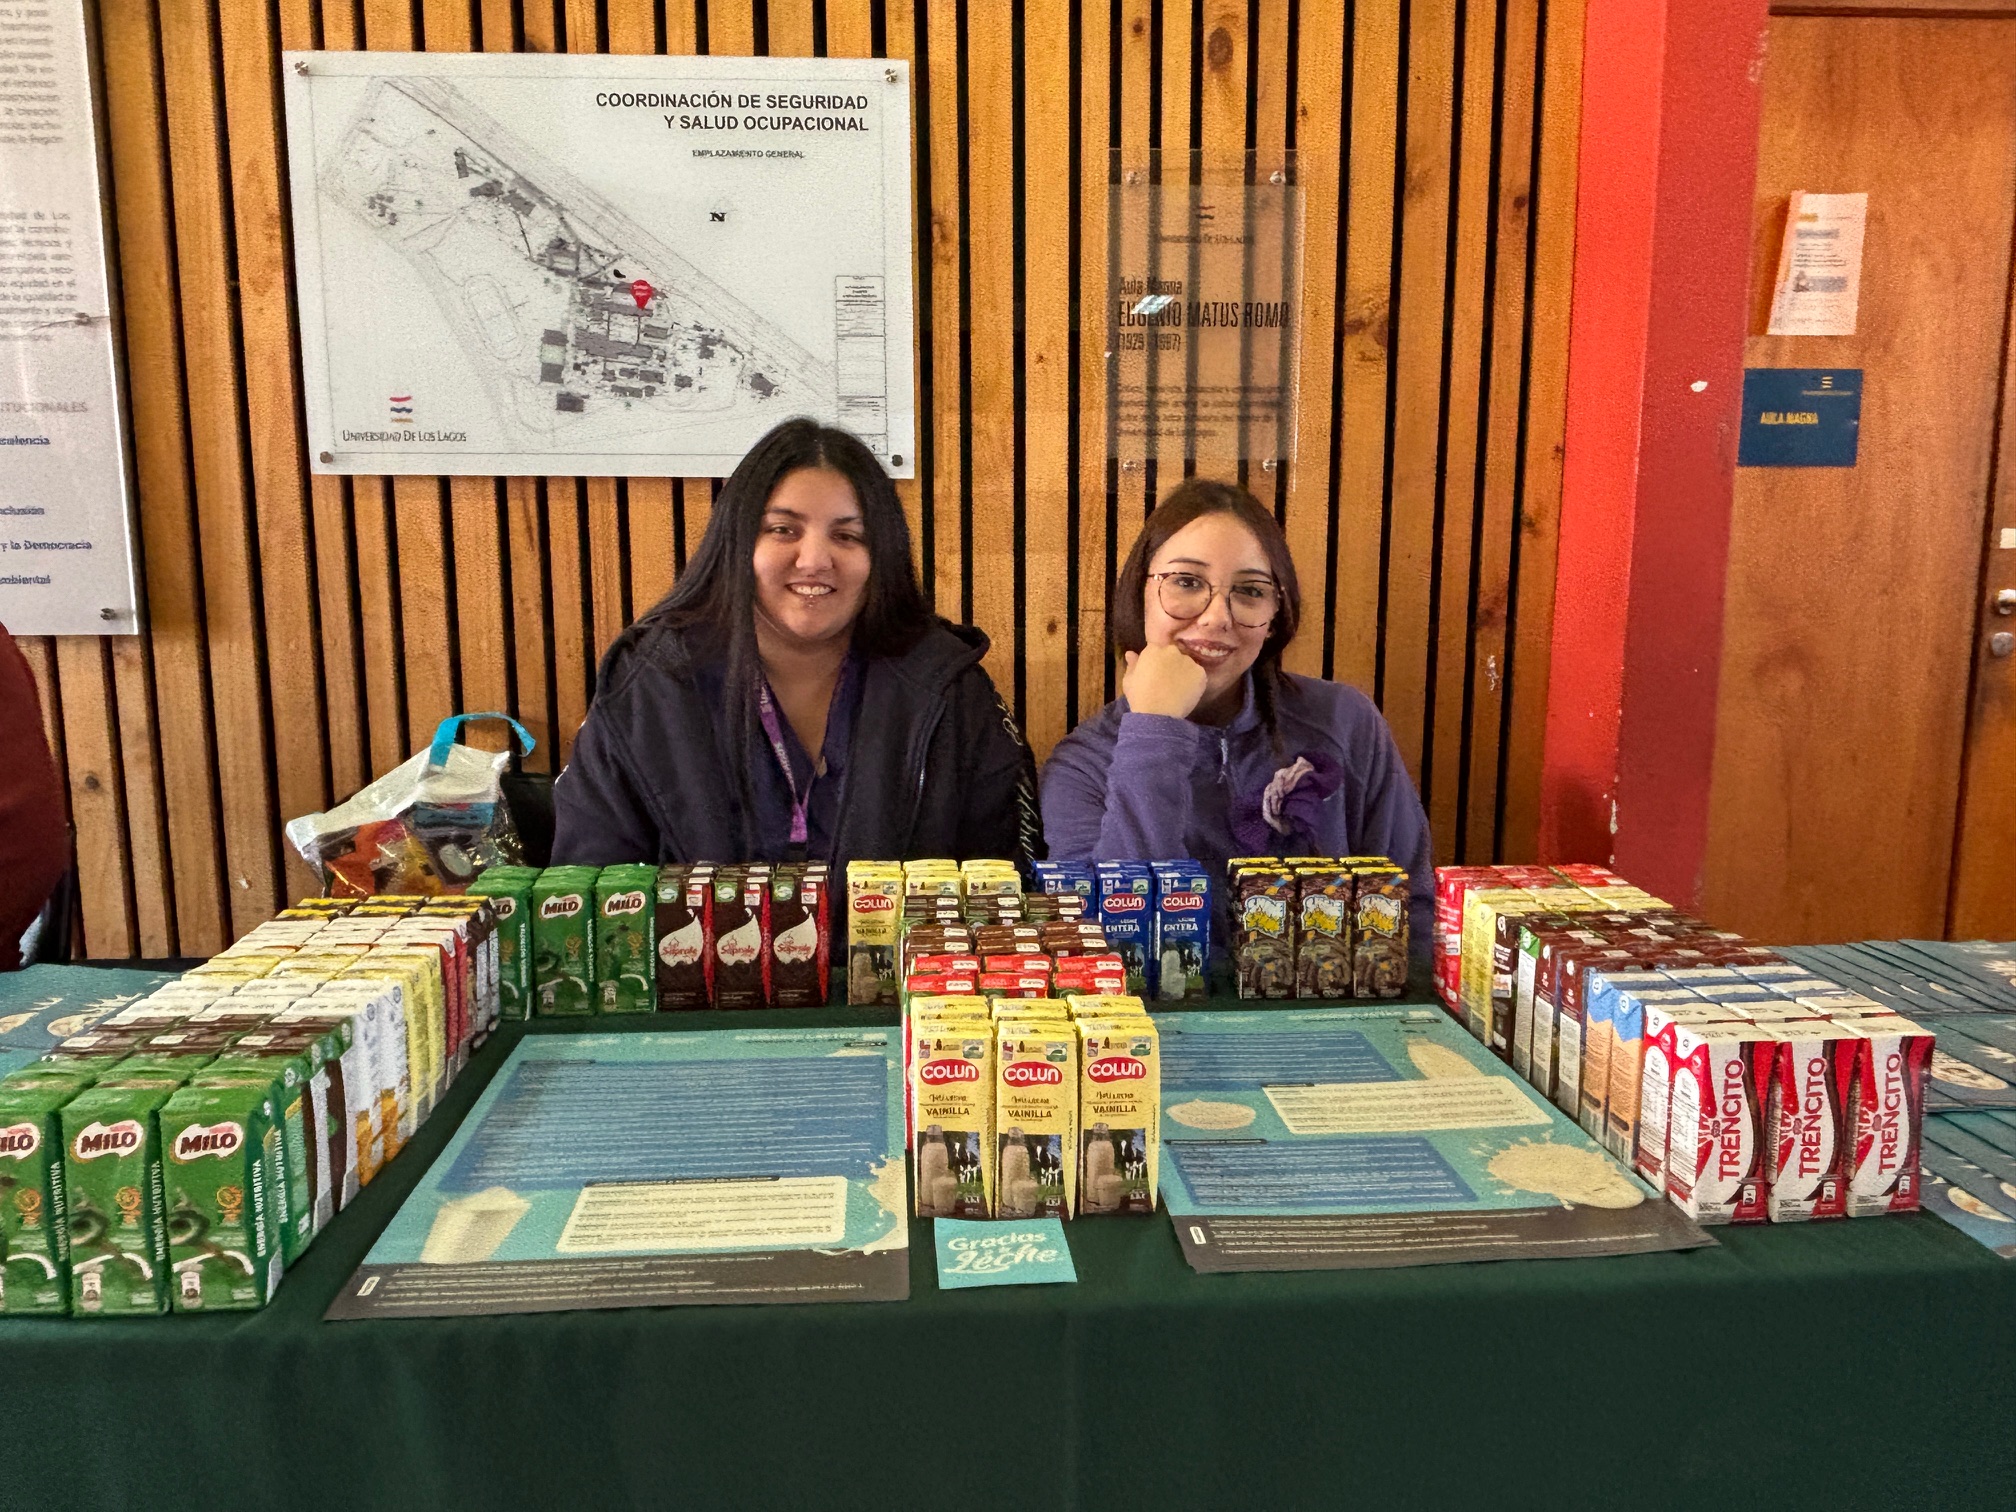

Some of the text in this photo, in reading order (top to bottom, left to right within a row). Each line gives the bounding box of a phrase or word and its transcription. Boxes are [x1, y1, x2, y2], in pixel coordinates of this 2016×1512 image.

[595, 90, 868, 109] COORDINACIÓN DE SEGURIDAD
[663, 115, 869, 131] Y SALUD OCUPACIONAL
[765, 149, 805, 159] GENERAL
[709, 211, 727, 223] N
[1118, 300, 1290, 328] EUGENIO MATUS ROMO
[1760, 411, 1819, 425] AULA MAGNA
[544, 900, 579, 915] MILO
[608, 898, 643, 912] MILO
[1104, 898, 1142, 907] COLUN
[1163, 896, 1201, 907] COLUN
[1105, 923, 1140, 933] ENTERA
[922, 1065, 976, 1079] COLUN
[1004, 1068, 1060, 1082] COLUN
[1089, 1062, 1143, 1077] COLUN
[926, 1107, 970, 1116] VAINILLA
[1007, 1109, 1053, 1118] VAINILLA
[1093, 1105, 1137, 1113] VAINILLA
[1878, 1053, 1902, 1176] TRENCITO
[1718, 1060, 1743, 1183] TRENCITO
[1798, 1058, 1826, 1178] TRENCITO
[80, 1131, 137, 1153] MILO
[180, 1132, 238, 1154] MILO
[947, 1232, 1047, 1251] Gracias
[943, 1243, 1059, 1274] Leche
